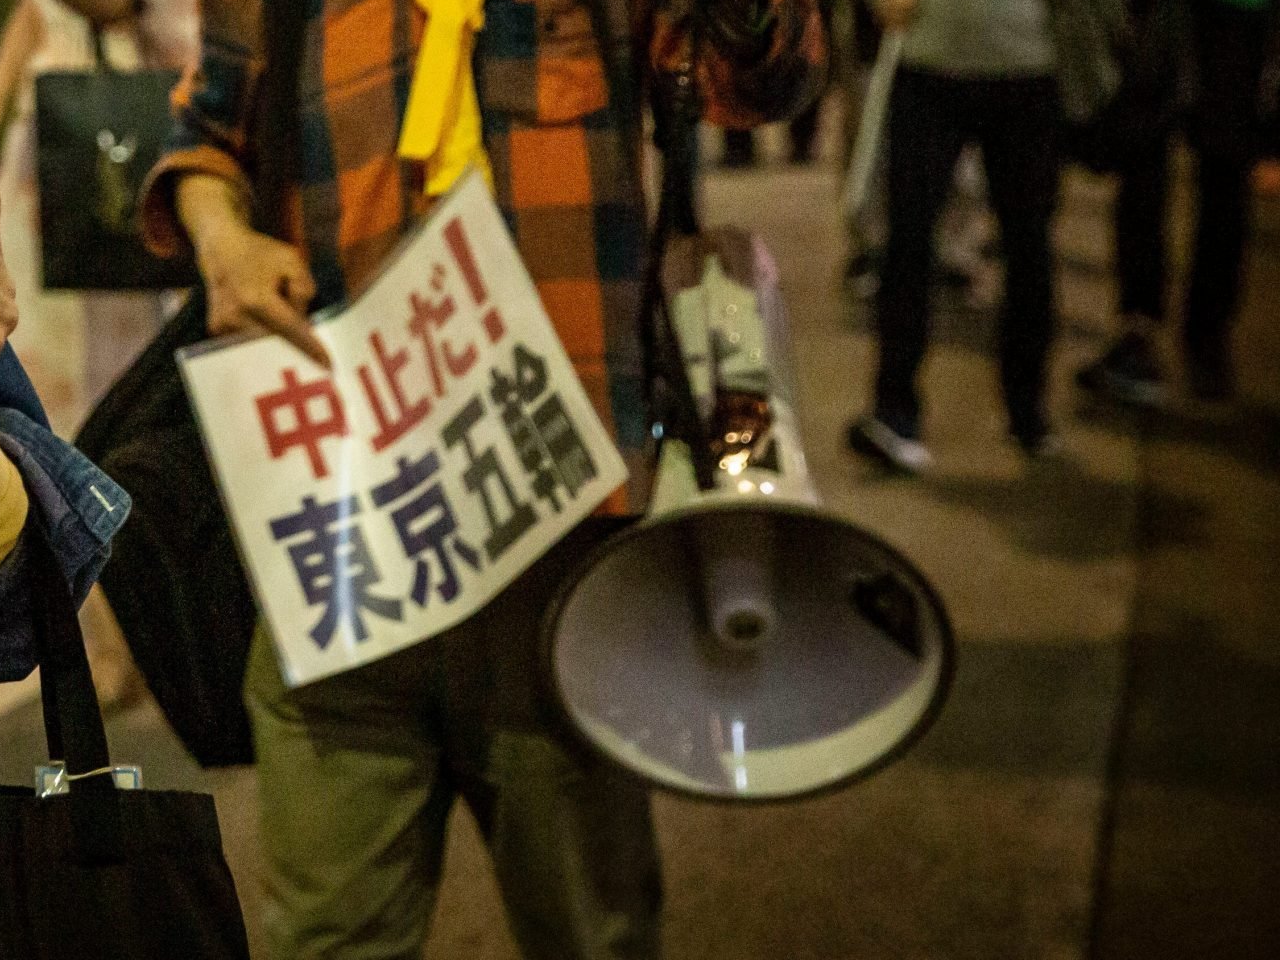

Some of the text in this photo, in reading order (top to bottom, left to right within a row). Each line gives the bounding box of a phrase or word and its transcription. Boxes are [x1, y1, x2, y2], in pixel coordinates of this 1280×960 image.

[254, 216, 509, 481] 中止だ!
[270, 342, 598, 652] 東京五輪
